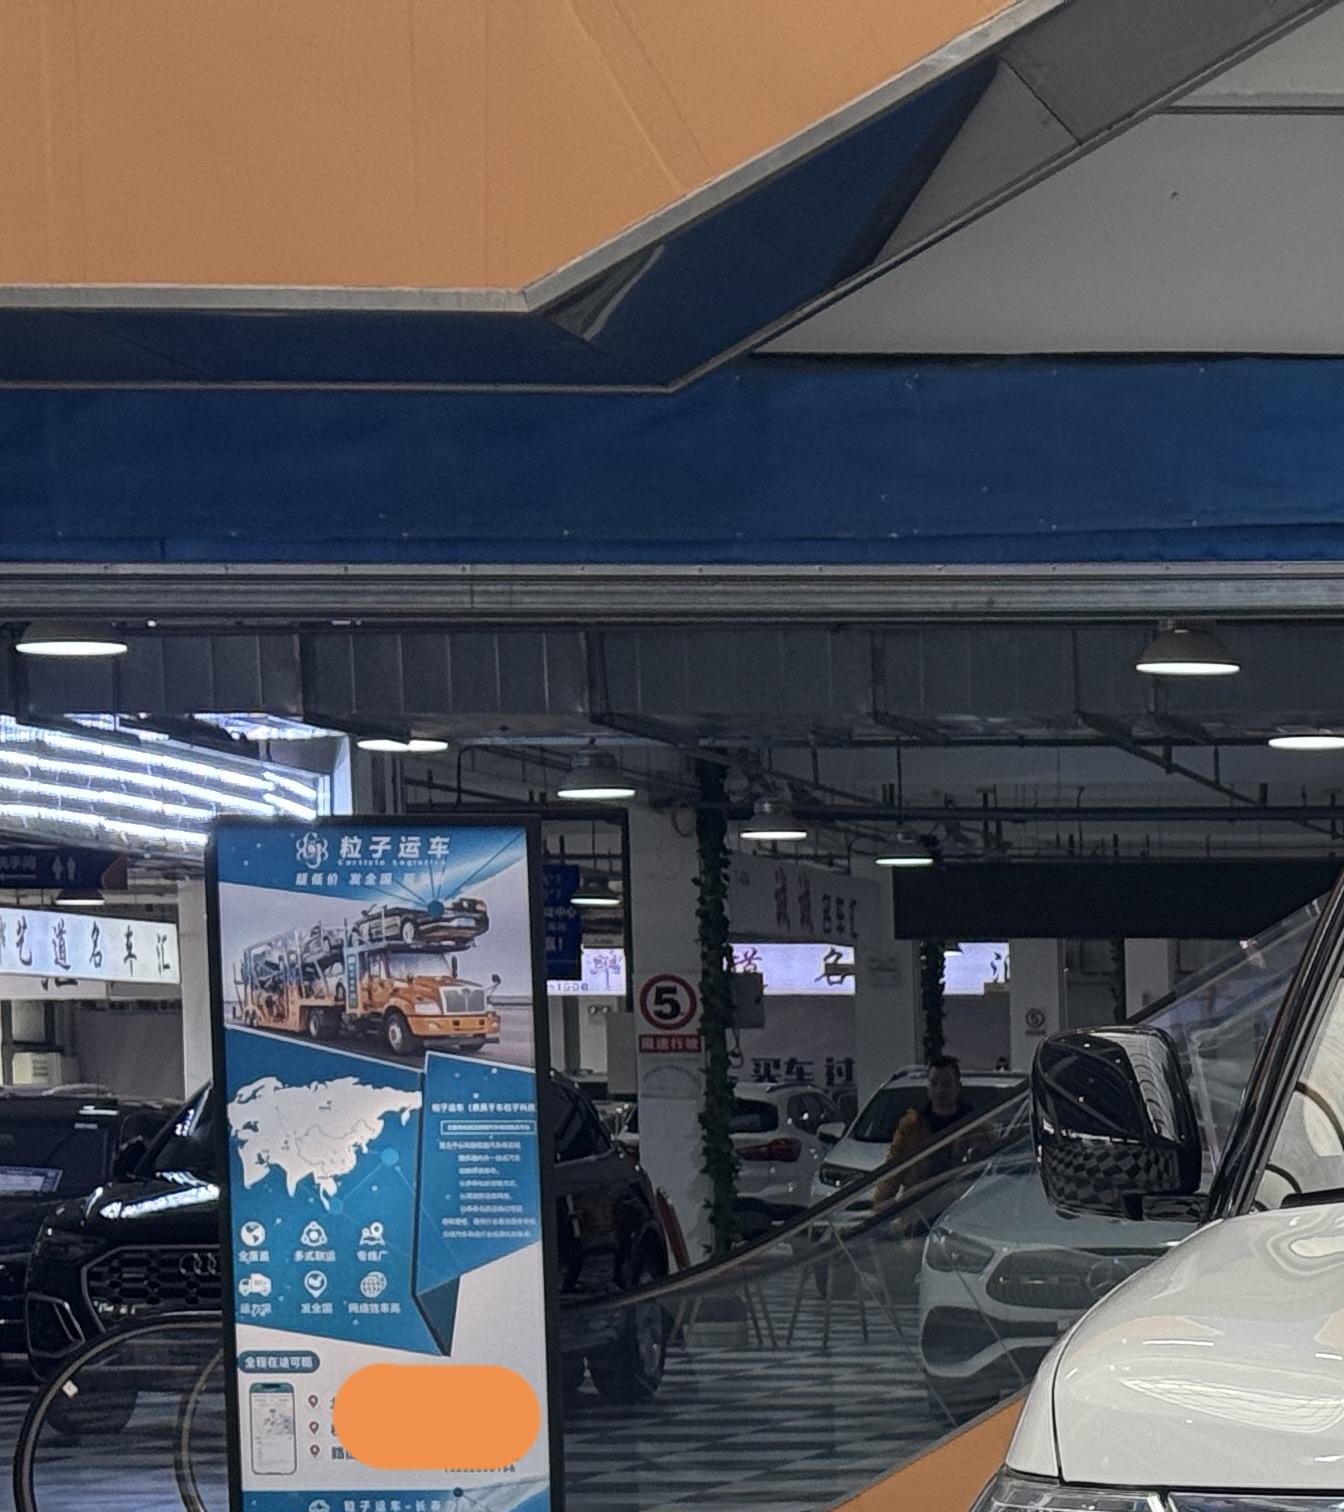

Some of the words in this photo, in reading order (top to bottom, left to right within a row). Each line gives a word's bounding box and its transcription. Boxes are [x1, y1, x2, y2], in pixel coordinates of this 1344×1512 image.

[340, 836, 450, 859] 粒子运车
[0, 915, 171, 976] 艺道名车汇
[654, 986, 681, 1020] 5
